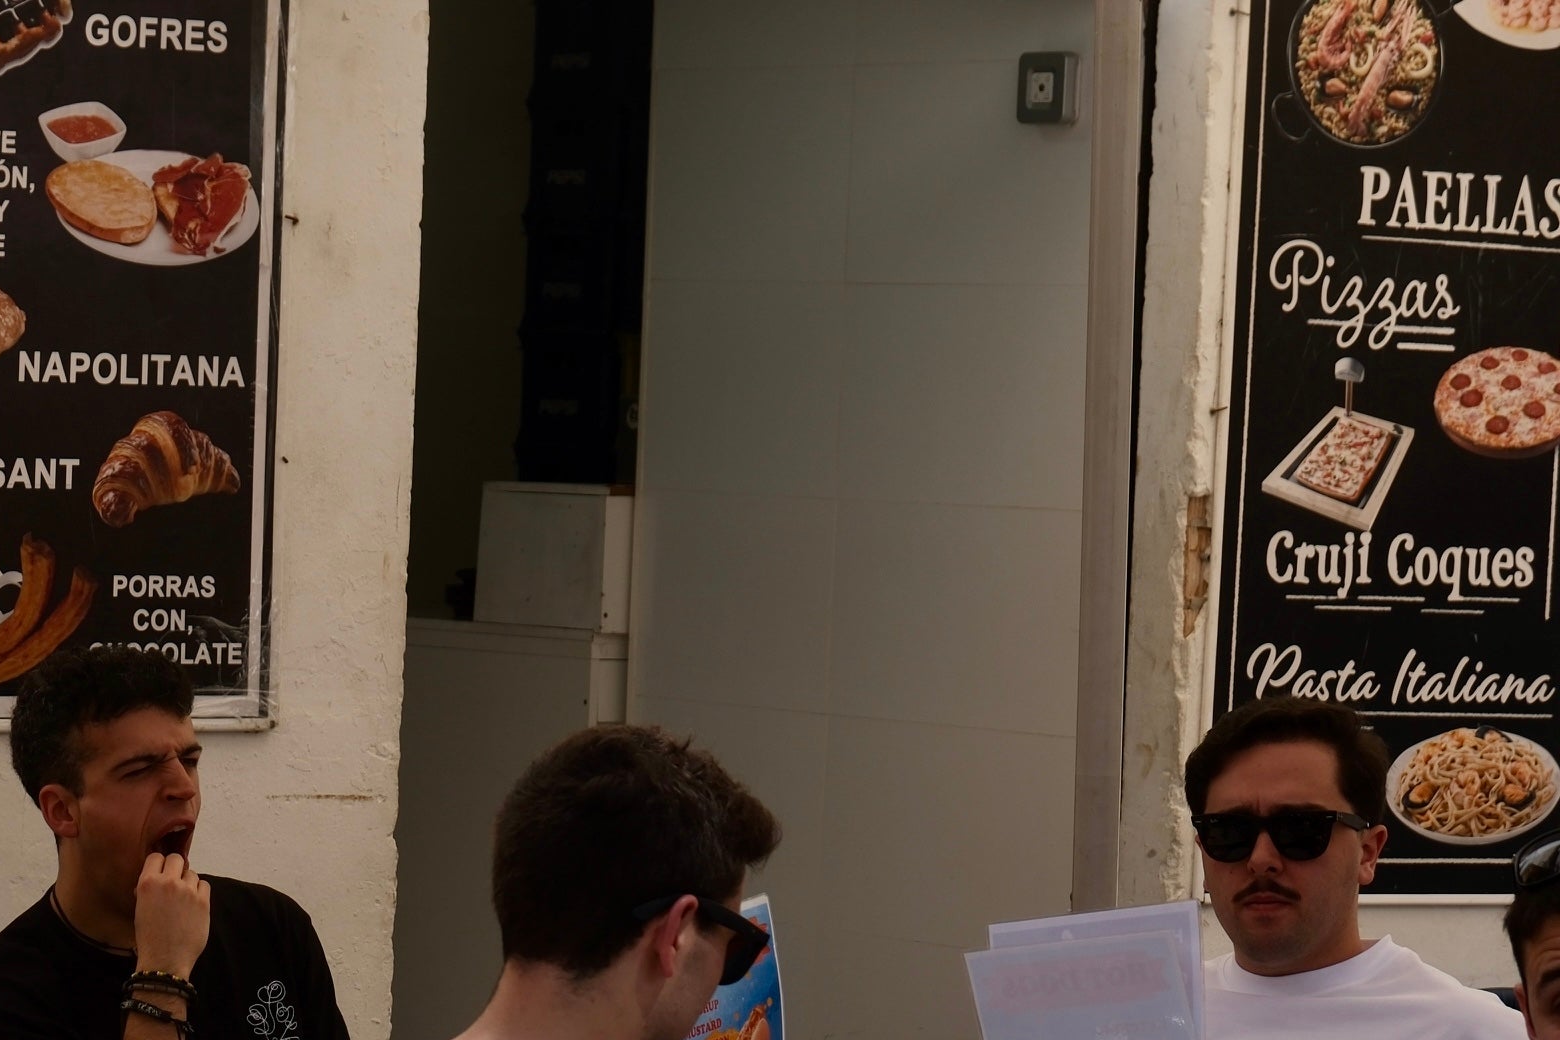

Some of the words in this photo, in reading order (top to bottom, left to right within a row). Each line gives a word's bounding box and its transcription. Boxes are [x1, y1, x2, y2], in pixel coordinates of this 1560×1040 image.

[85, 13, 228, 53] GOFRES
[1357, 164, 1560, 239] PAELLAS
[1269, 239, 1461, 350] Pizzas
[17, 350, 246, 388] NAPOLITANA
[1265, 530, 1372, 599] Cruji
[1387, 532, 1535, 600] Coques
[112, 574, 216, 599] PORRAS
[132, 608, 194, 635] CON,
[89, 641, 243, 665] OLATE
[1246, 642, 1381, 702] Pasta
[1391, 648, 1556, 704] Italiana
